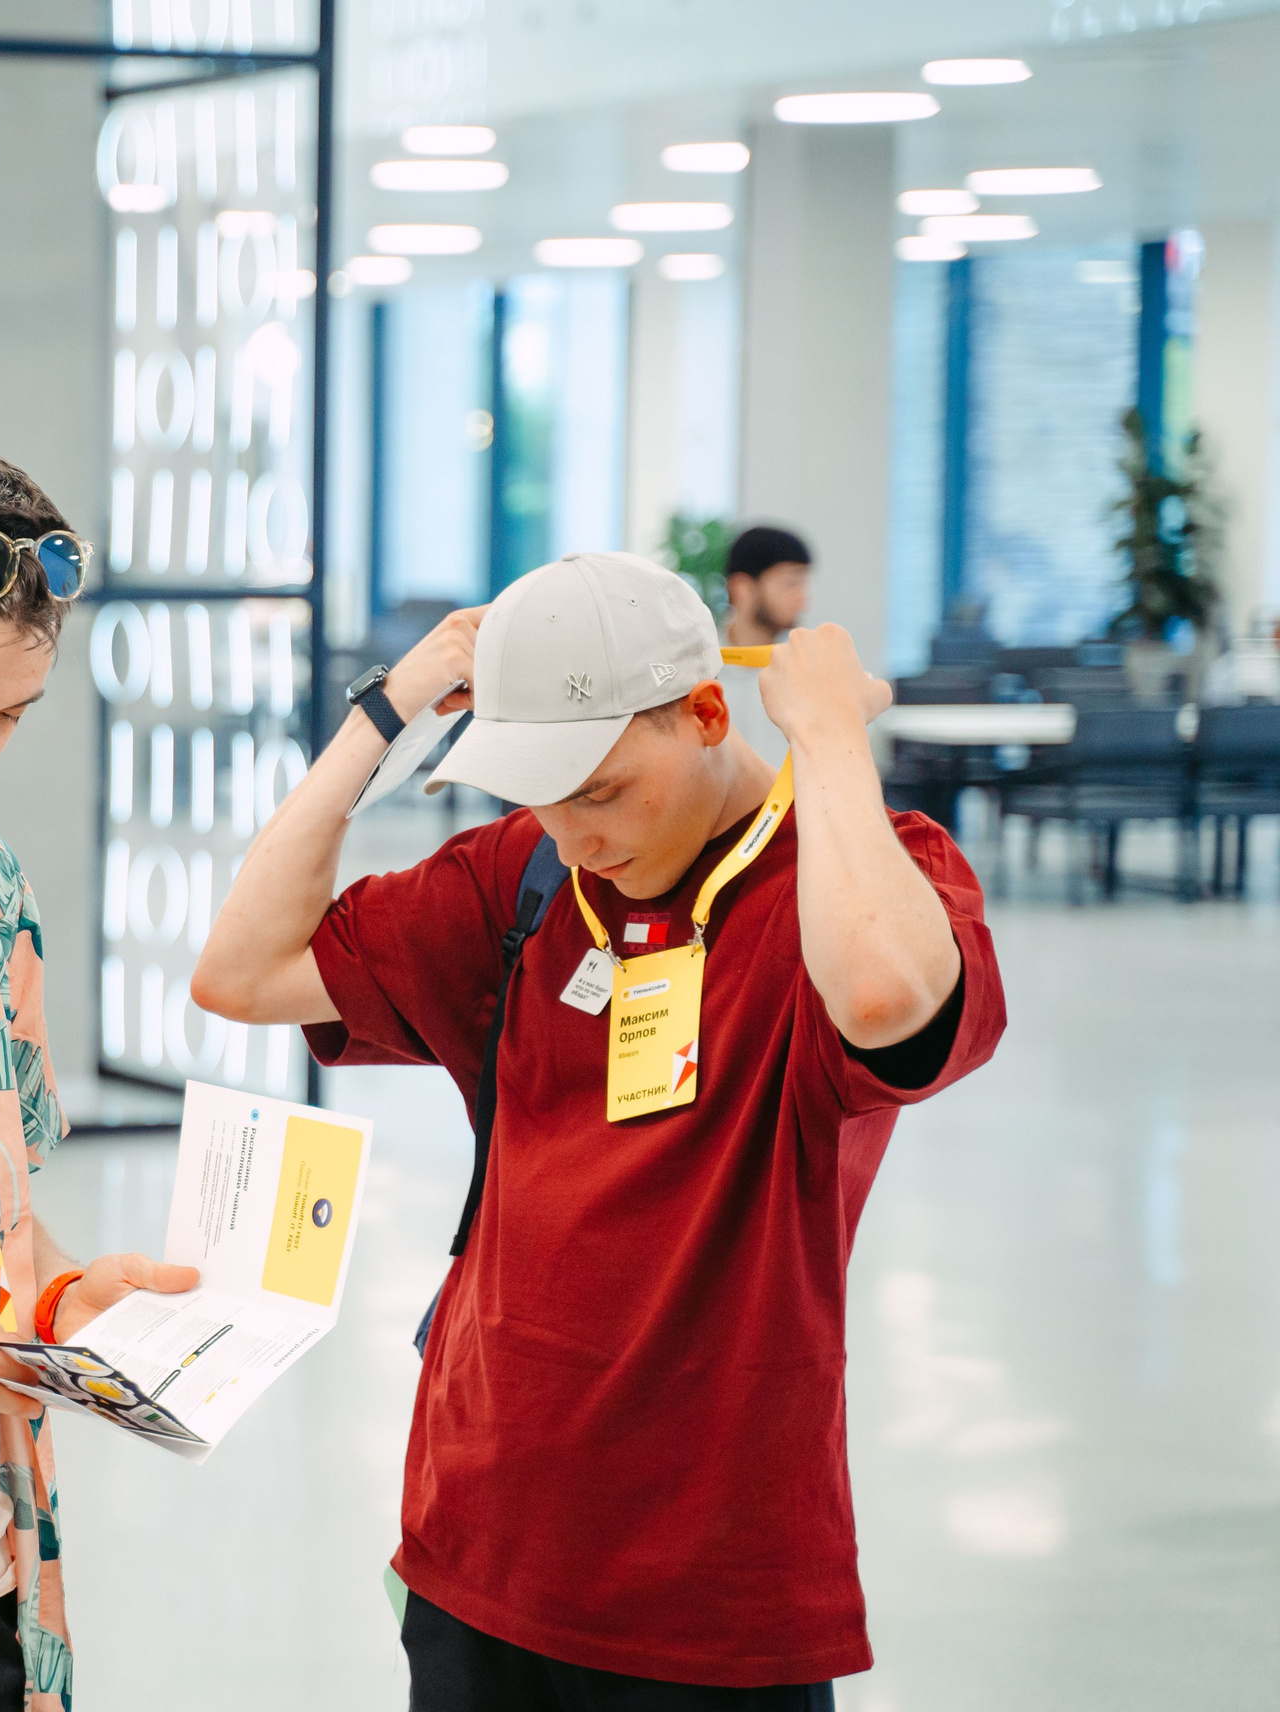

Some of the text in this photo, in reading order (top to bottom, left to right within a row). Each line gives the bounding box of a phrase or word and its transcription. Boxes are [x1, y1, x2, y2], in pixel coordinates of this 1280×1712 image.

[633, 982, 667, 996] ТИНЬКОФФ
[620, 1008, 669, 1028] Максим
[619, 1026, 657, 1045] Орлов
[617, 1084, 668, 1104] УЧАСТНИК
[242, 1127, 257, 1192] Расписание
[229, 1191, 240, 1231] чайной
[299, 1194, 308, 1221] Tinkoff
